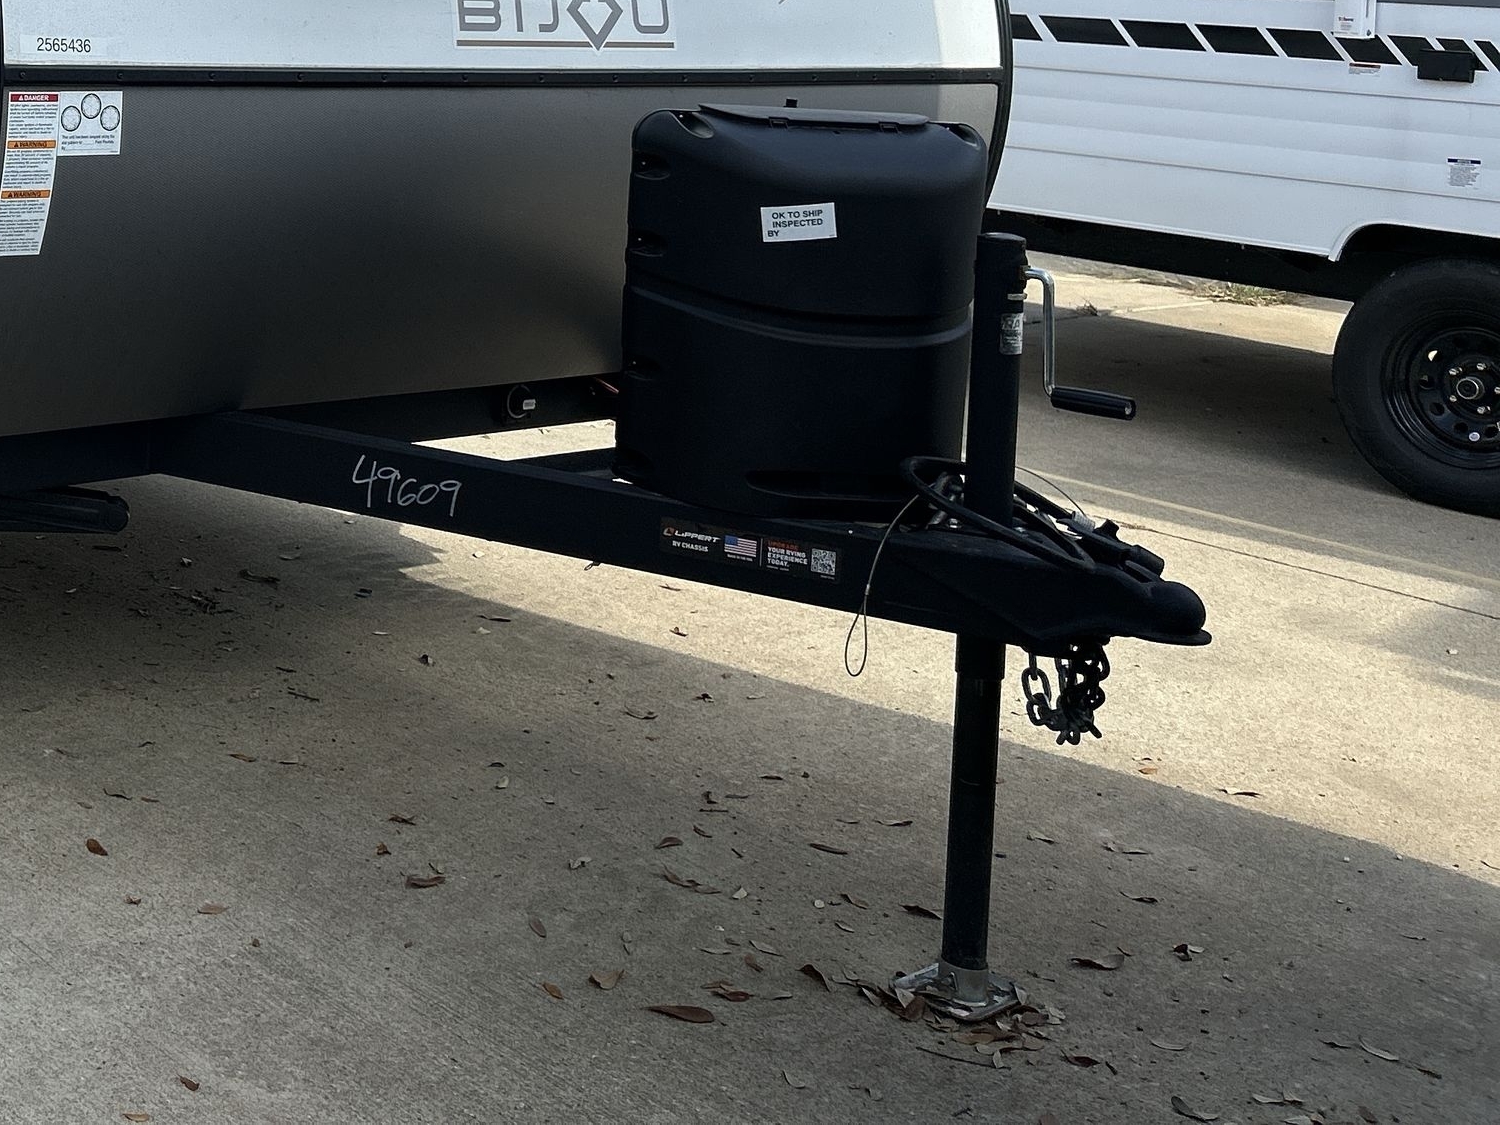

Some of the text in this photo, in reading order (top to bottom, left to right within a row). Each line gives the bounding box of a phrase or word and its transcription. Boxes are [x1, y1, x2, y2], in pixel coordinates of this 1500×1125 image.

[36, 37, 92, 53] 2565436
[24, 94, 50, 102] DANGER
[802, 209, 823, 218] SHIP
[772, 218, 823, 229] INSPECTED
[767, 230, 779, 238] BY
[352, 454, 462, 517] 49609
[674, 530, 721, 543] LIPPERT
[681, 542, 709, 552] CHASSIS
[767, 546, 806, 558] YOUR RVING
[767, 552, 808, 565] EXPERIENCE
